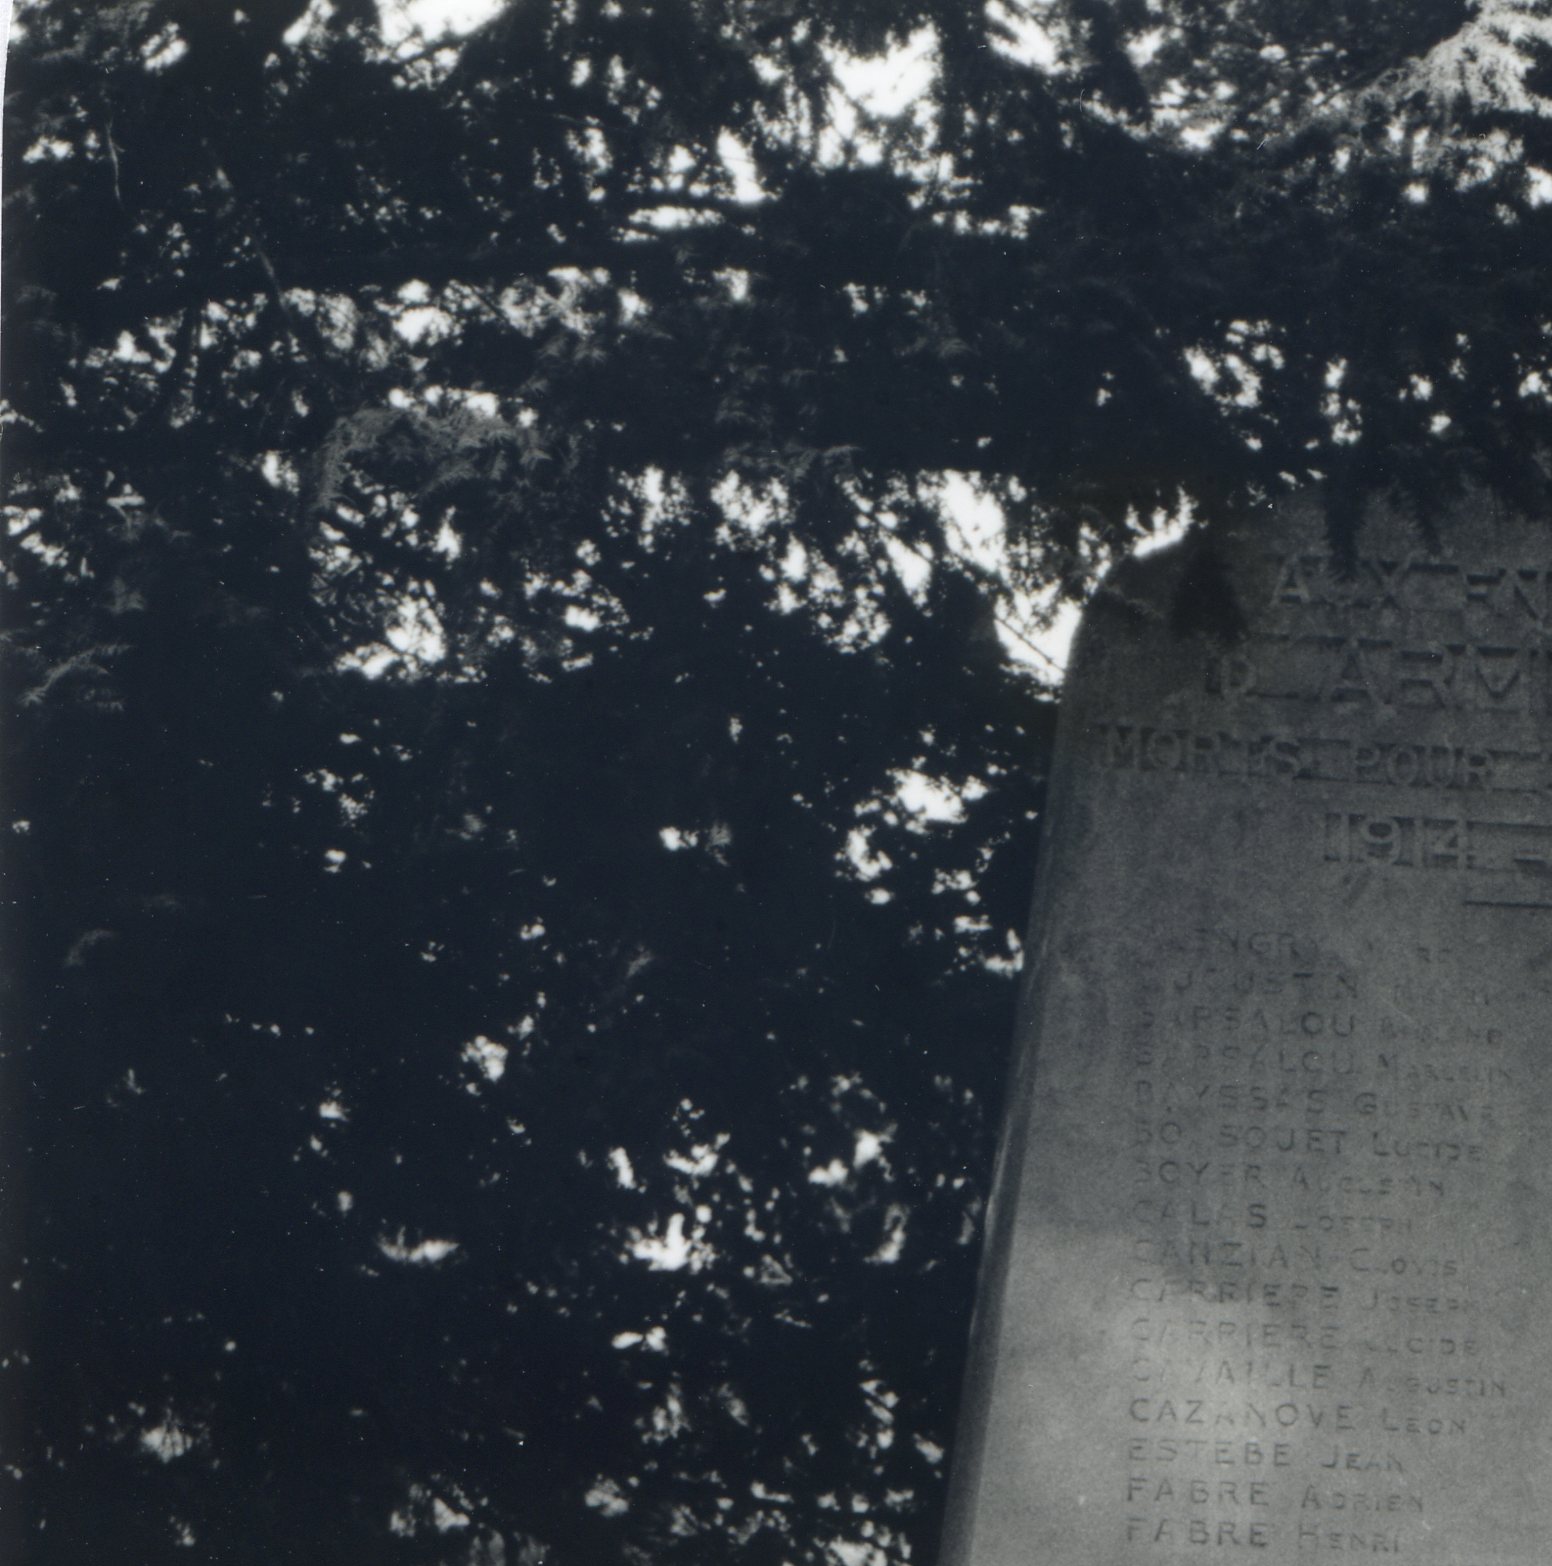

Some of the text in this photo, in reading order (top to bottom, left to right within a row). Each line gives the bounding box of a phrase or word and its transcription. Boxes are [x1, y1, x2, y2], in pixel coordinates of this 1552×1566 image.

[1353, 740, 1497, 793] POUR
[1335, 810, 1475, 868] 1914
[1127, 1436, 1291, 1467] ESTEBE
[1126, 1476, 1269, 1508] FABRE
[1125, 1515, 1400, 1555] FABRE HENRI
